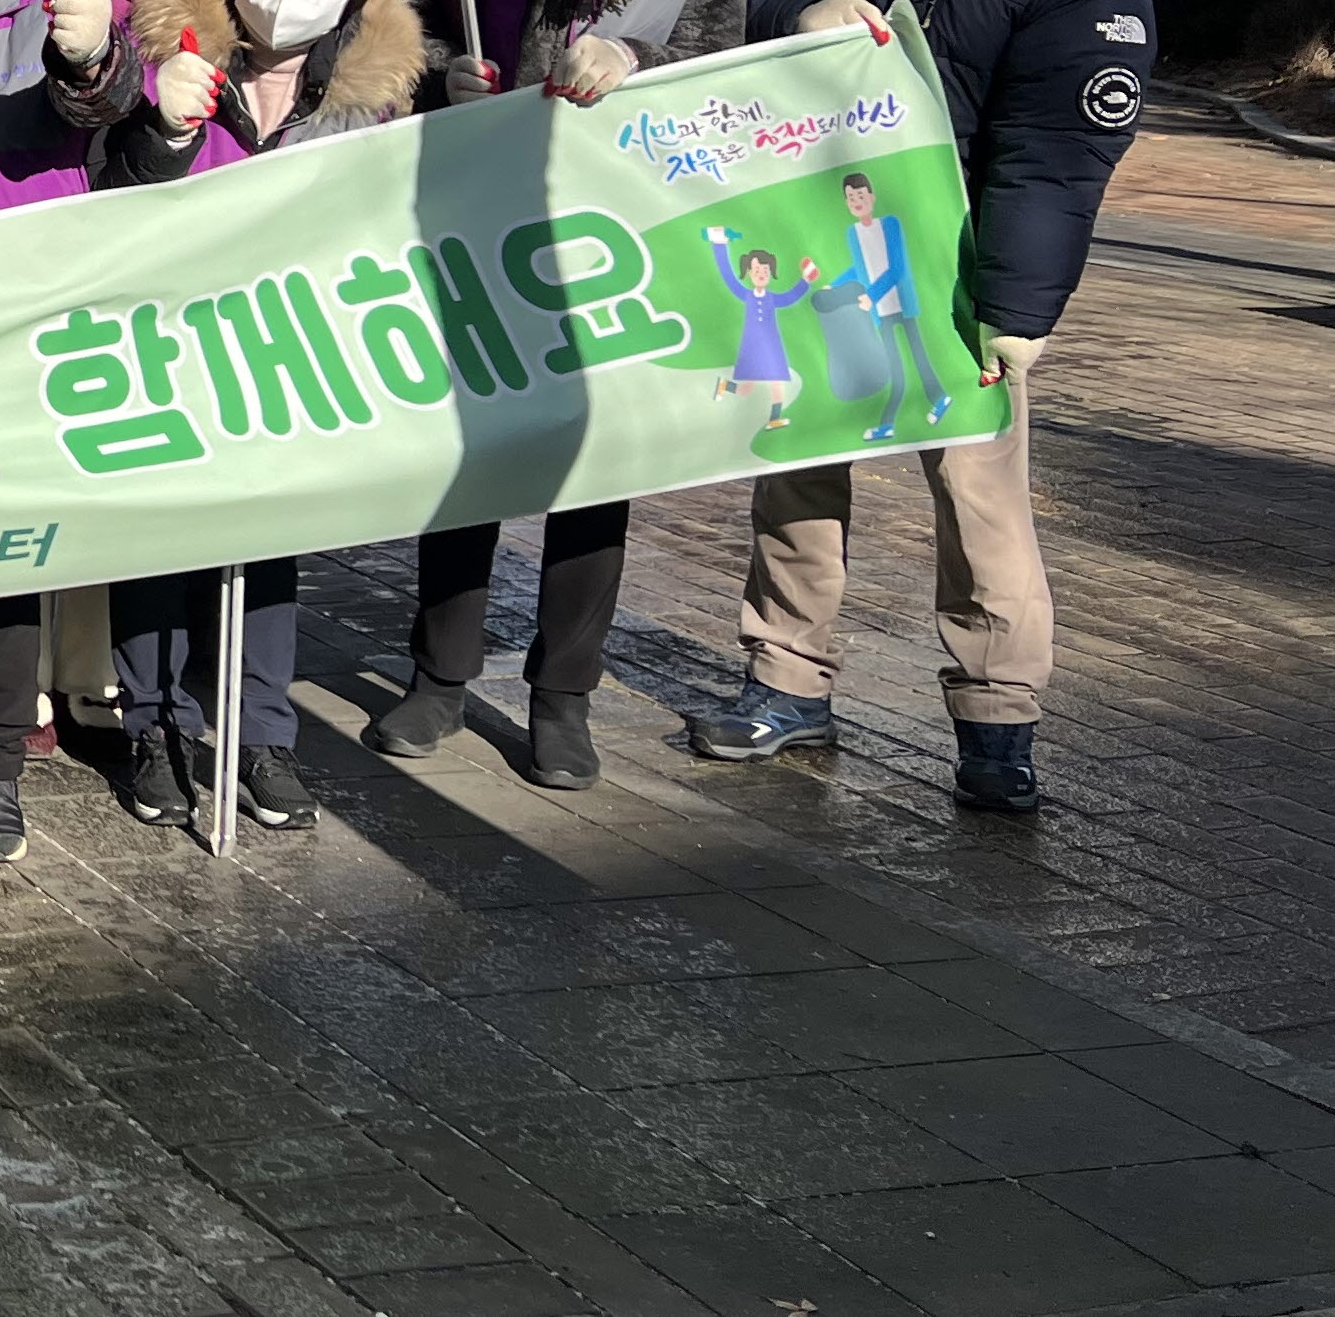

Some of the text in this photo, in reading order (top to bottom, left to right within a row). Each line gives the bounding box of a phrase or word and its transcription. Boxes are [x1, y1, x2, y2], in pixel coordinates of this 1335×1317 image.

[619, 113, 705, 161] 시민과
[752, 93, 906, 157] 혁신도시 안산
[35, 210, 687, 475] 함께해요
